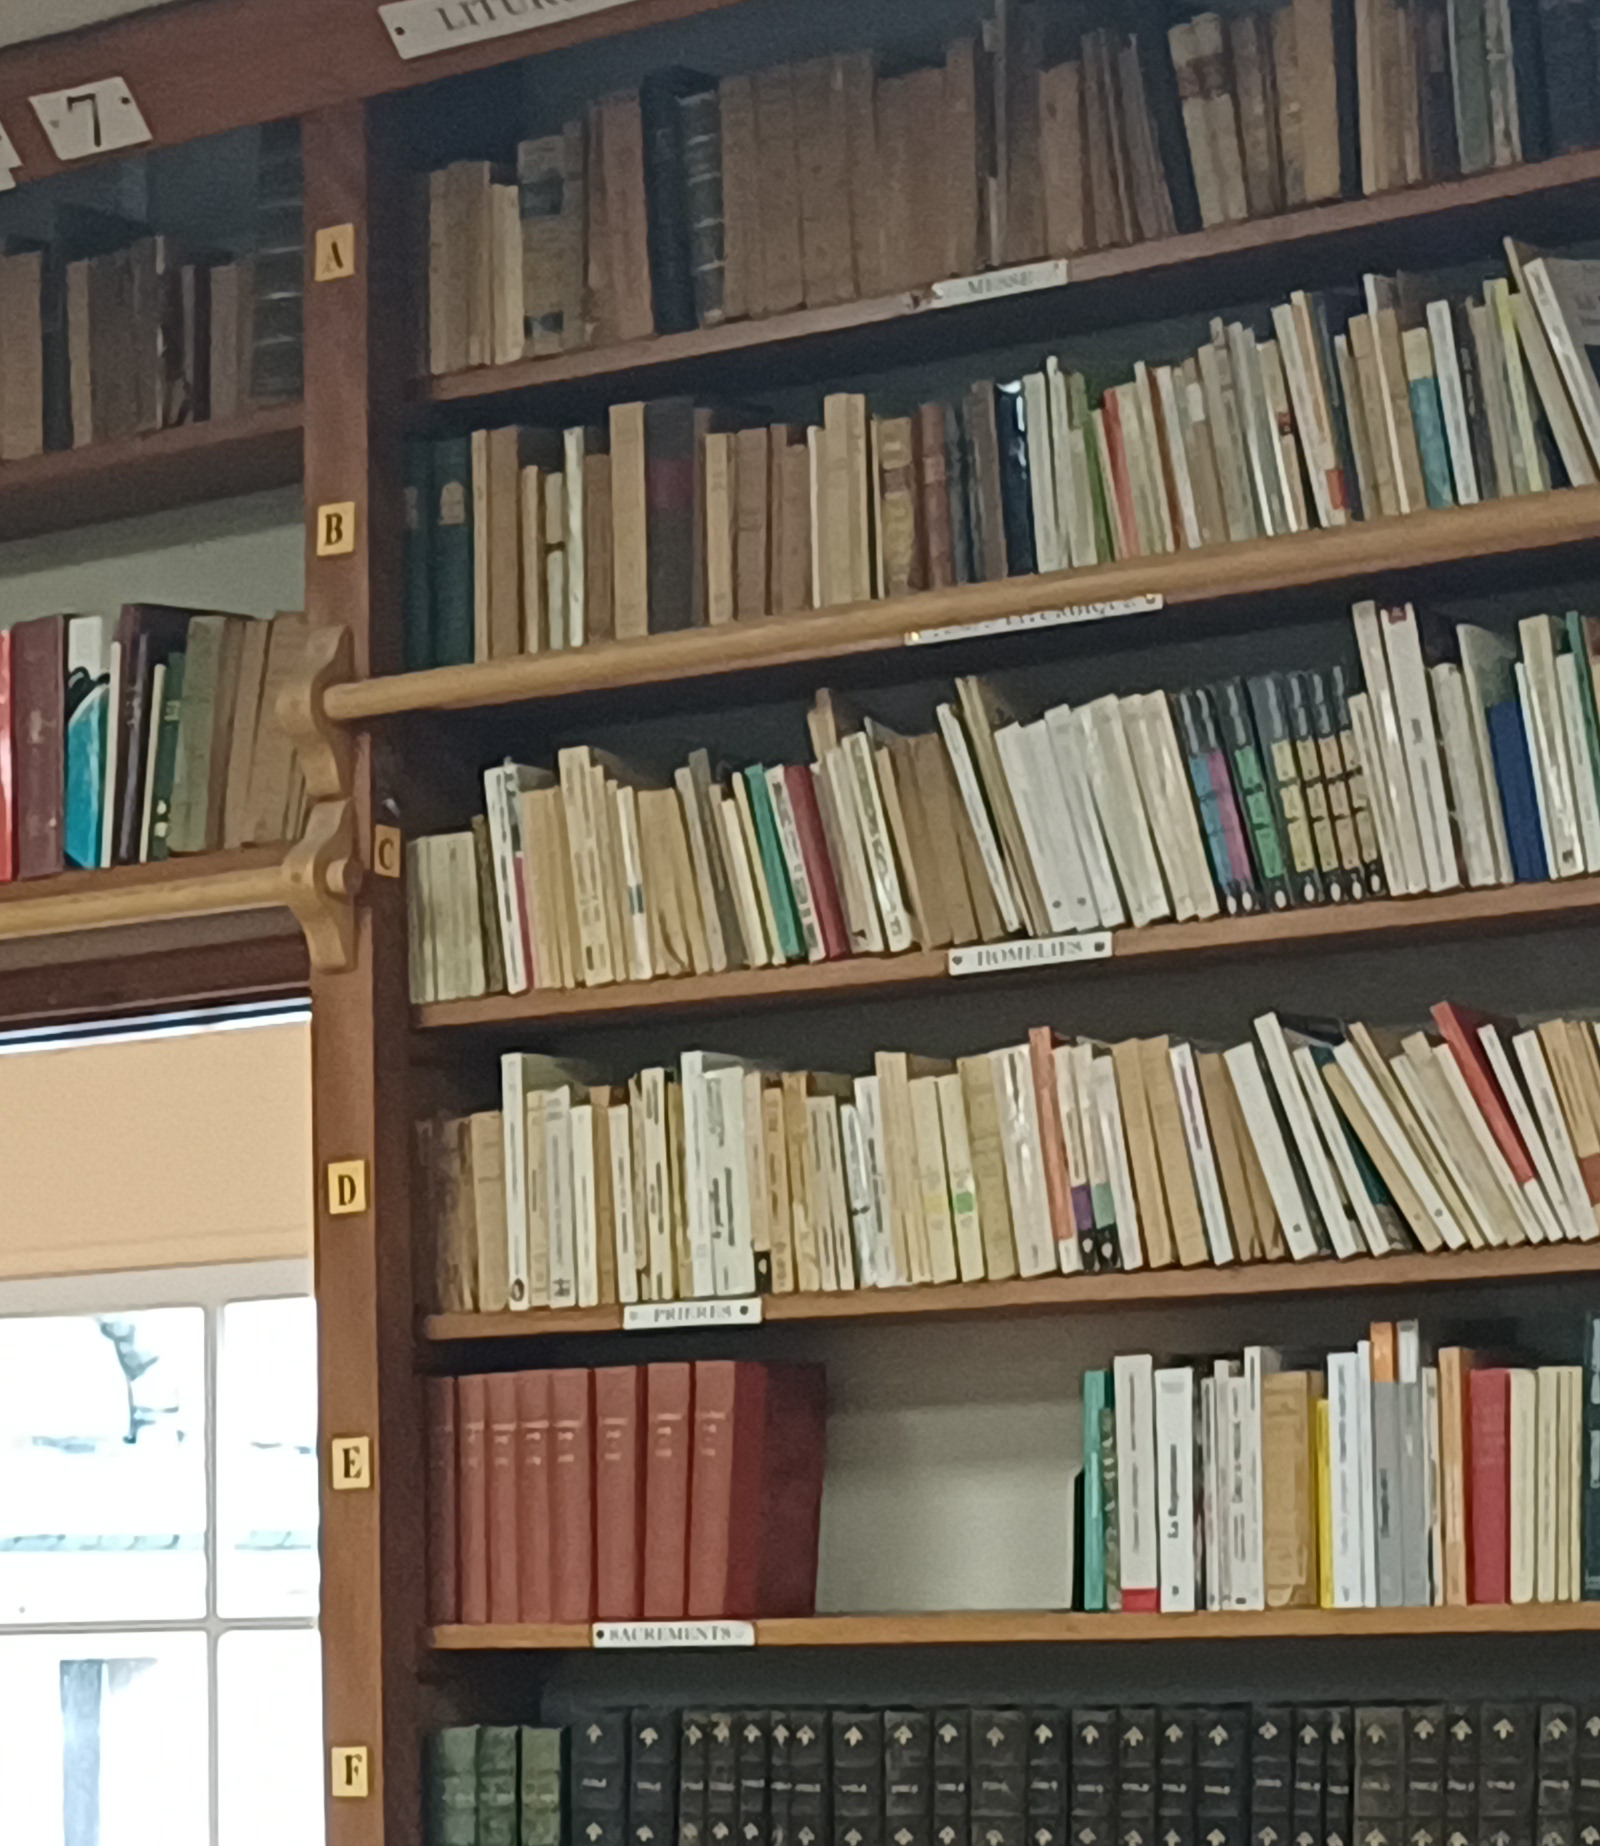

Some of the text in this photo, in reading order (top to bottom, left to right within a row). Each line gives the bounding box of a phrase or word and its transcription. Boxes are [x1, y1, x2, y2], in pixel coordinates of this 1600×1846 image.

[65, 92, 103, 149] 7
[320, 240, 344, 276] A
[324, 513, 344, 546] B
[377, 839, 395, 870] C
[337, 1174, 358, 1208] D
[342, 1444, 364, 1479] E
[608, 1625, 733, 1643] SACREMENTS
[343, 1753, 364, 1787] F
